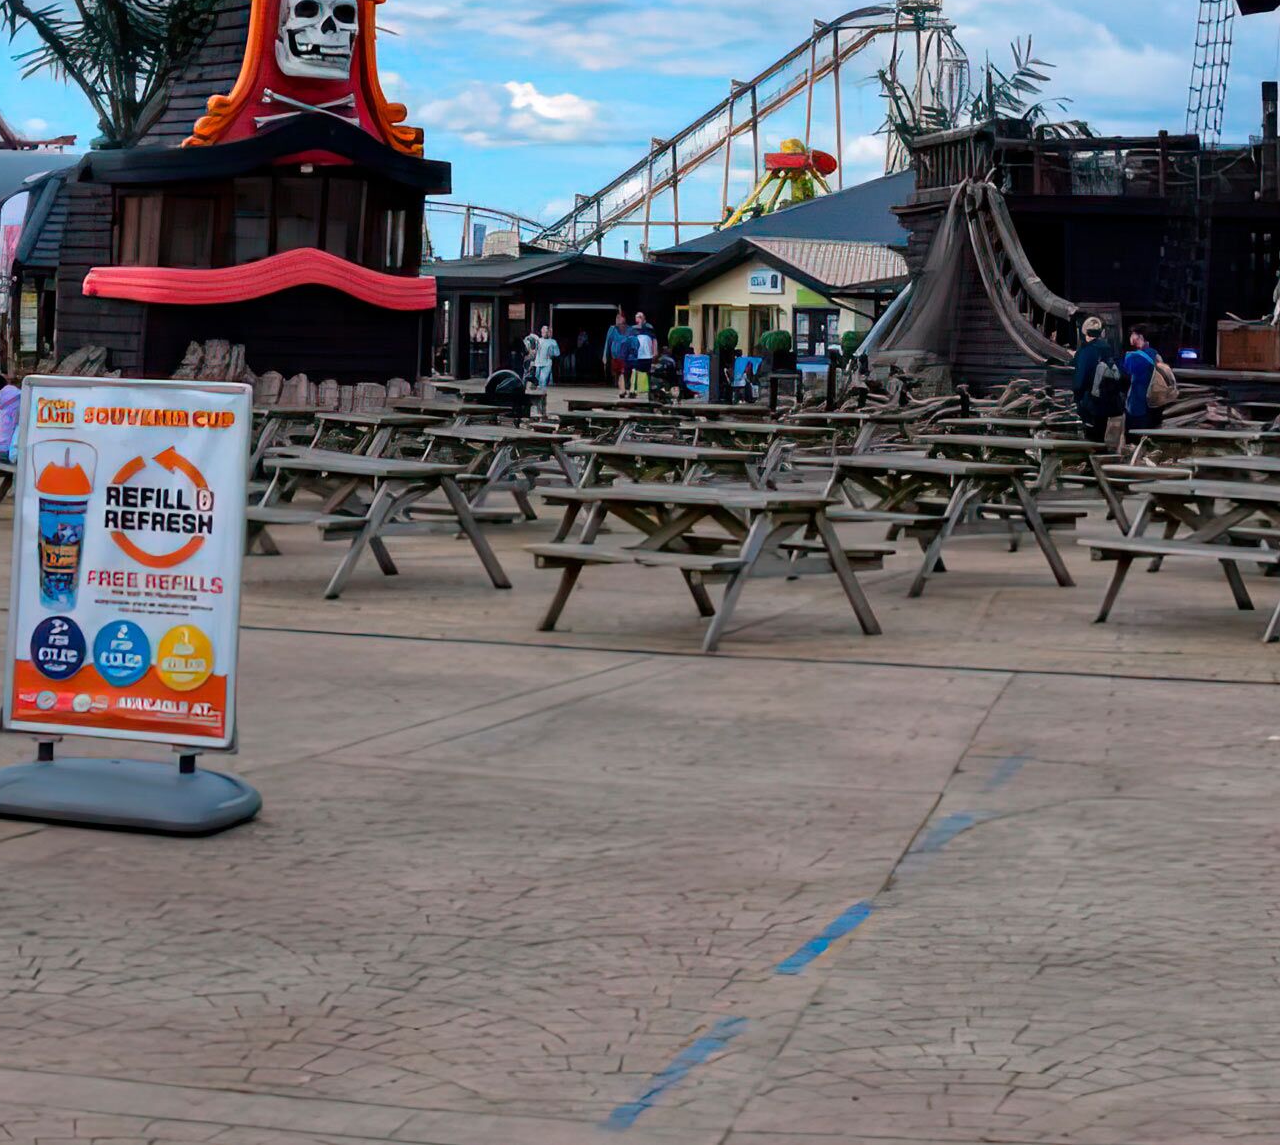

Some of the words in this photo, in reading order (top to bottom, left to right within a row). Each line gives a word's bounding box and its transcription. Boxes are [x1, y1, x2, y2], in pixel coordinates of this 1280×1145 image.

[192, 410, 235, 428] CUP
[106, 486, 191, 510] REFILL
[104, 510, 213, 534] REFRESH
[87, 570, 138, 588] FREE
[145, 574, 223, 593] REFILLS
